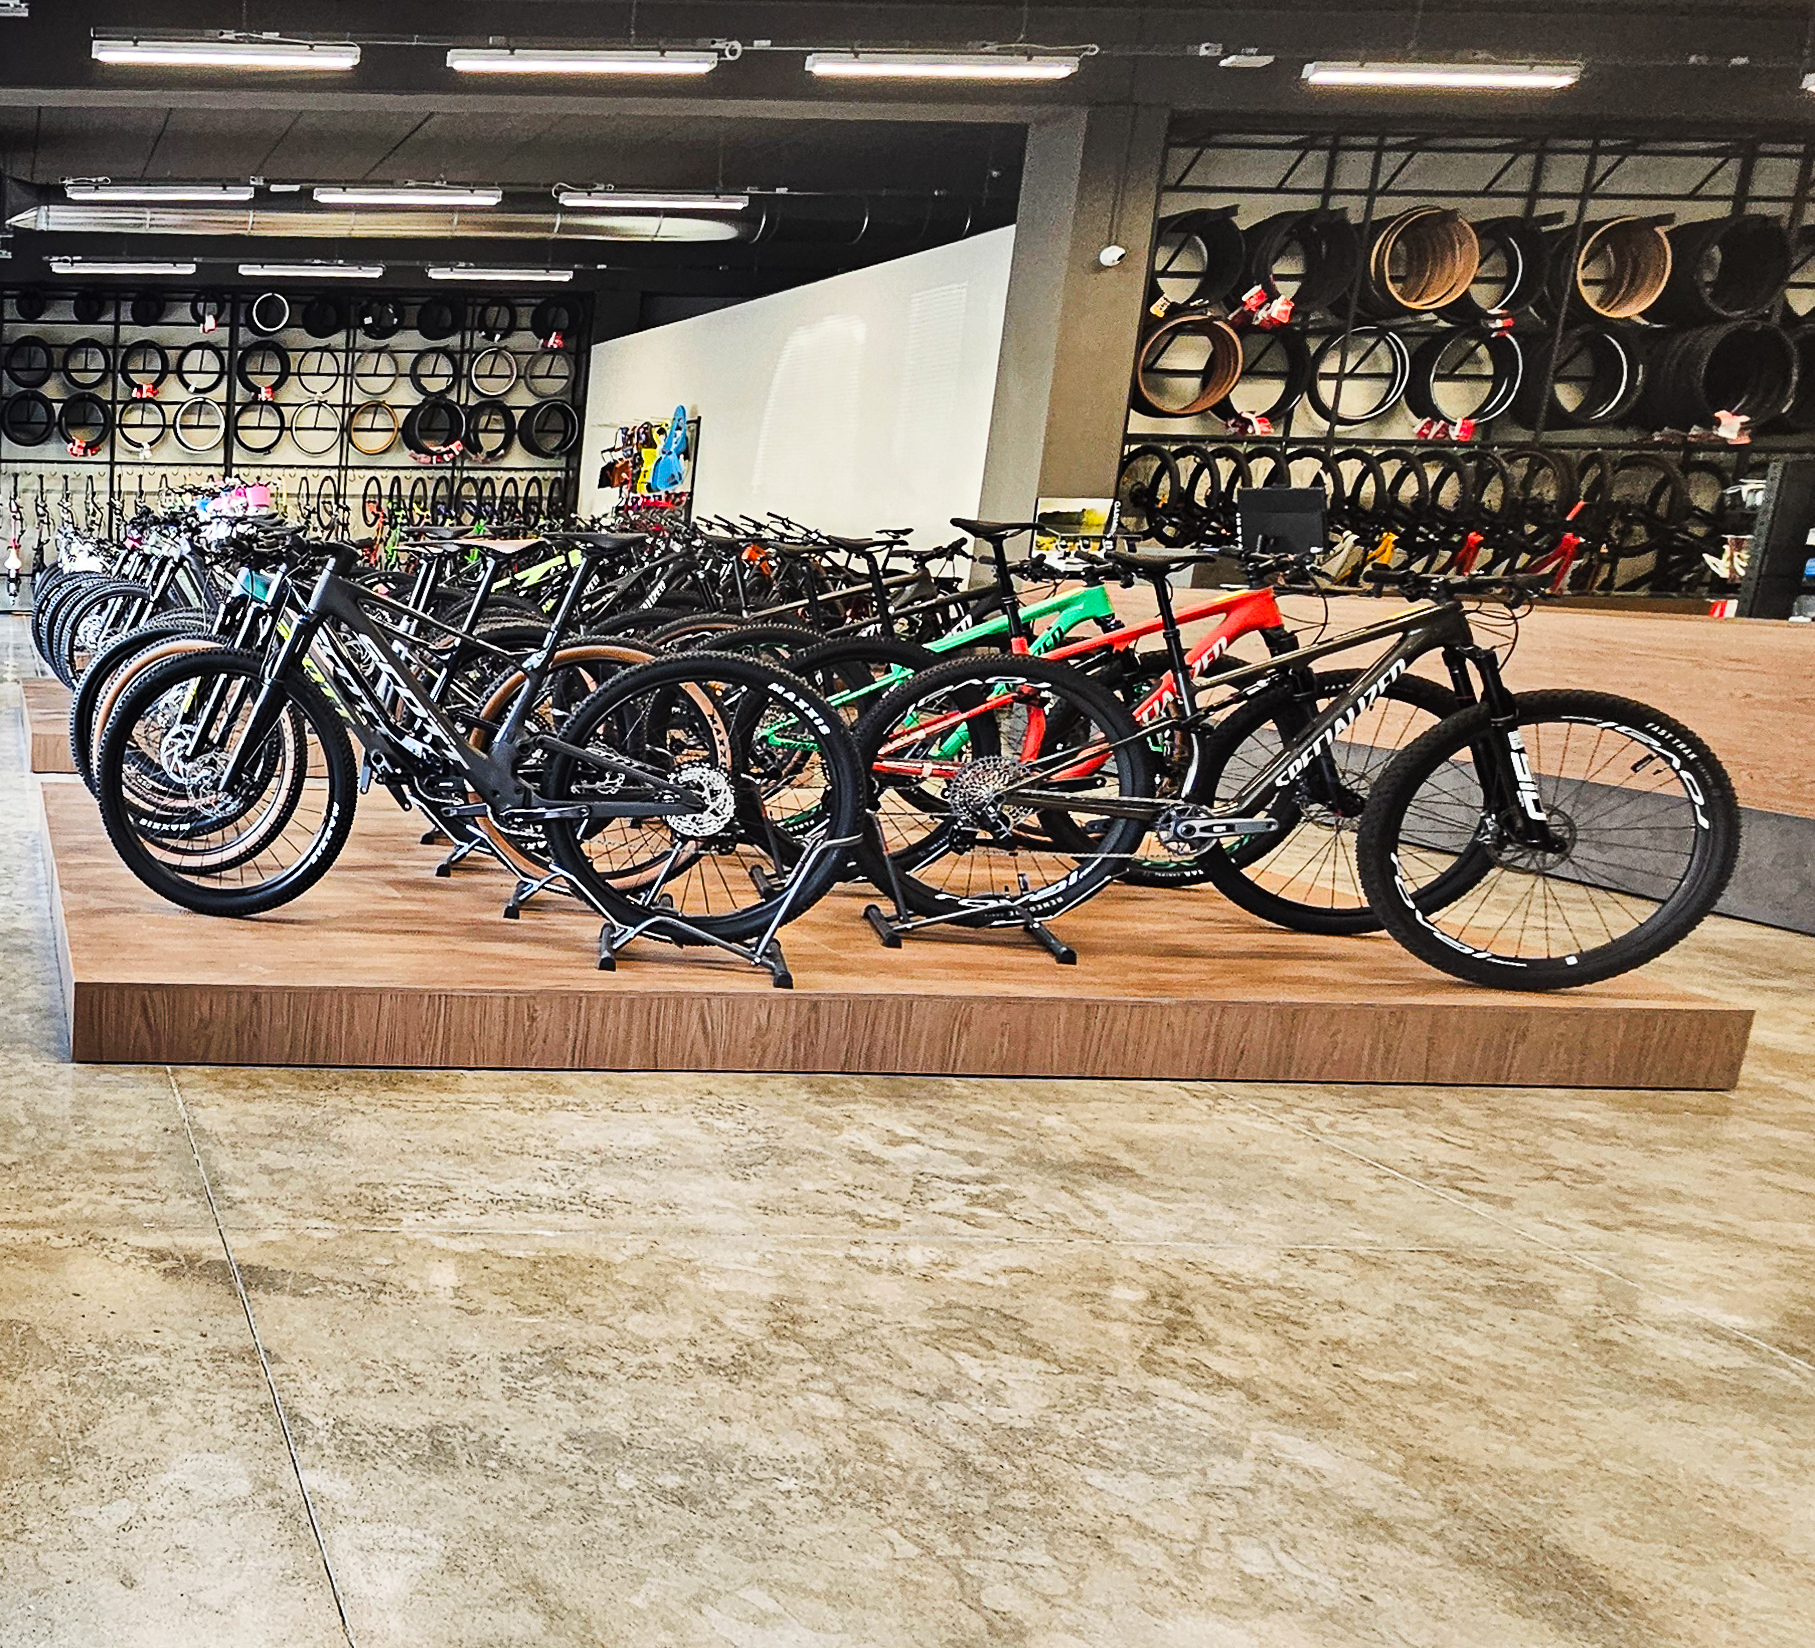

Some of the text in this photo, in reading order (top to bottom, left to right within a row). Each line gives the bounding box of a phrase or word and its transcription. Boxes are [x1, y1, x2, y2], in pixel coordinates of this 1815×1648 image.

[352, 631, 470, 770] SCOTT
[768, 682, 831, 735] MAXXIS
[1274, 658, 1407, 787] SPECIALIZED
[1645, 722, 1698, 761] FAST TRAK
[139, 818, 191, 831] MAXXIS
